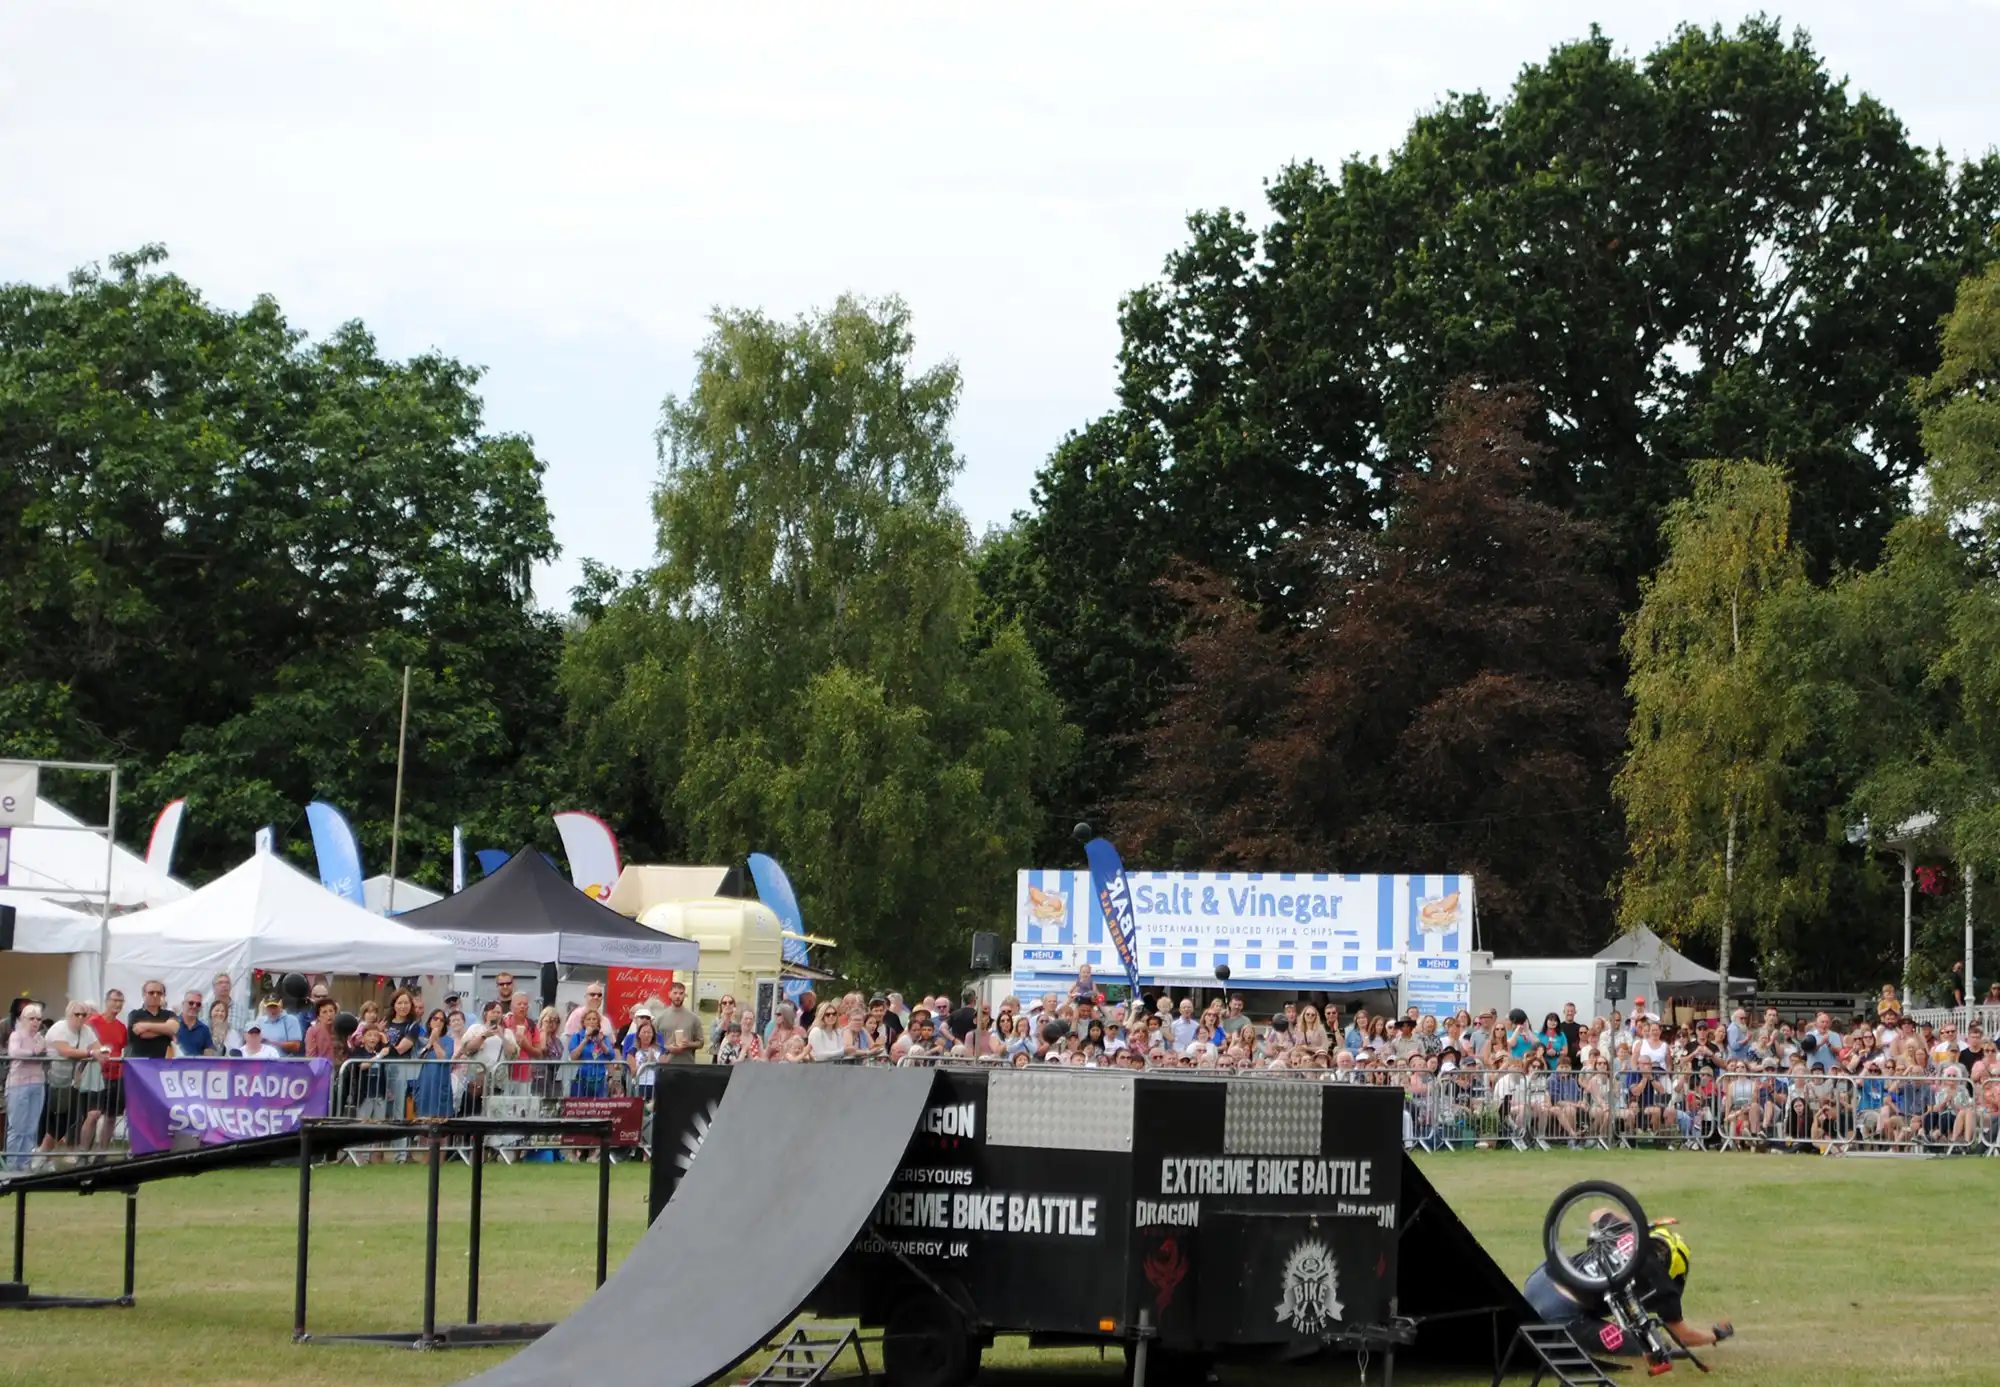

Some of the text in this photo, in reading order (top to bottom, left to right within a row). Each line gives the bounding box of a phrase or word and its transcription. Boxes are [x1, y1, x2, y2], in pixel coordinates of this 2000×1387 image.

[1135, 882, 1343, 925] Salt & Vinegar
[1147, 923, 1333, 937] SUSTAINABLY SOURCED FISH & CHIPS
[1031, 951, 1055, 960] MENU
[1426, 959, 1450, 968] MENU
[616, 969, 640, 982] Block
[161, 1072, 226, 1098] BBC
[234, 1075, 308, 1100] RADIO
[168, 1103, 305, 1137] SOMERSET
[922, 1102, 975, 1139] GON
[1161, 1158, 1372, 1195] EXTREME BIKE BATTLE
[953, 1193, 1004, 1231] BIKE
[1007, 1194, 1097, 1236] BATTLE
[1135, 1200, 1200, 1228] DRAGON
[1293, 1281, 1328, 1304] BIKE
